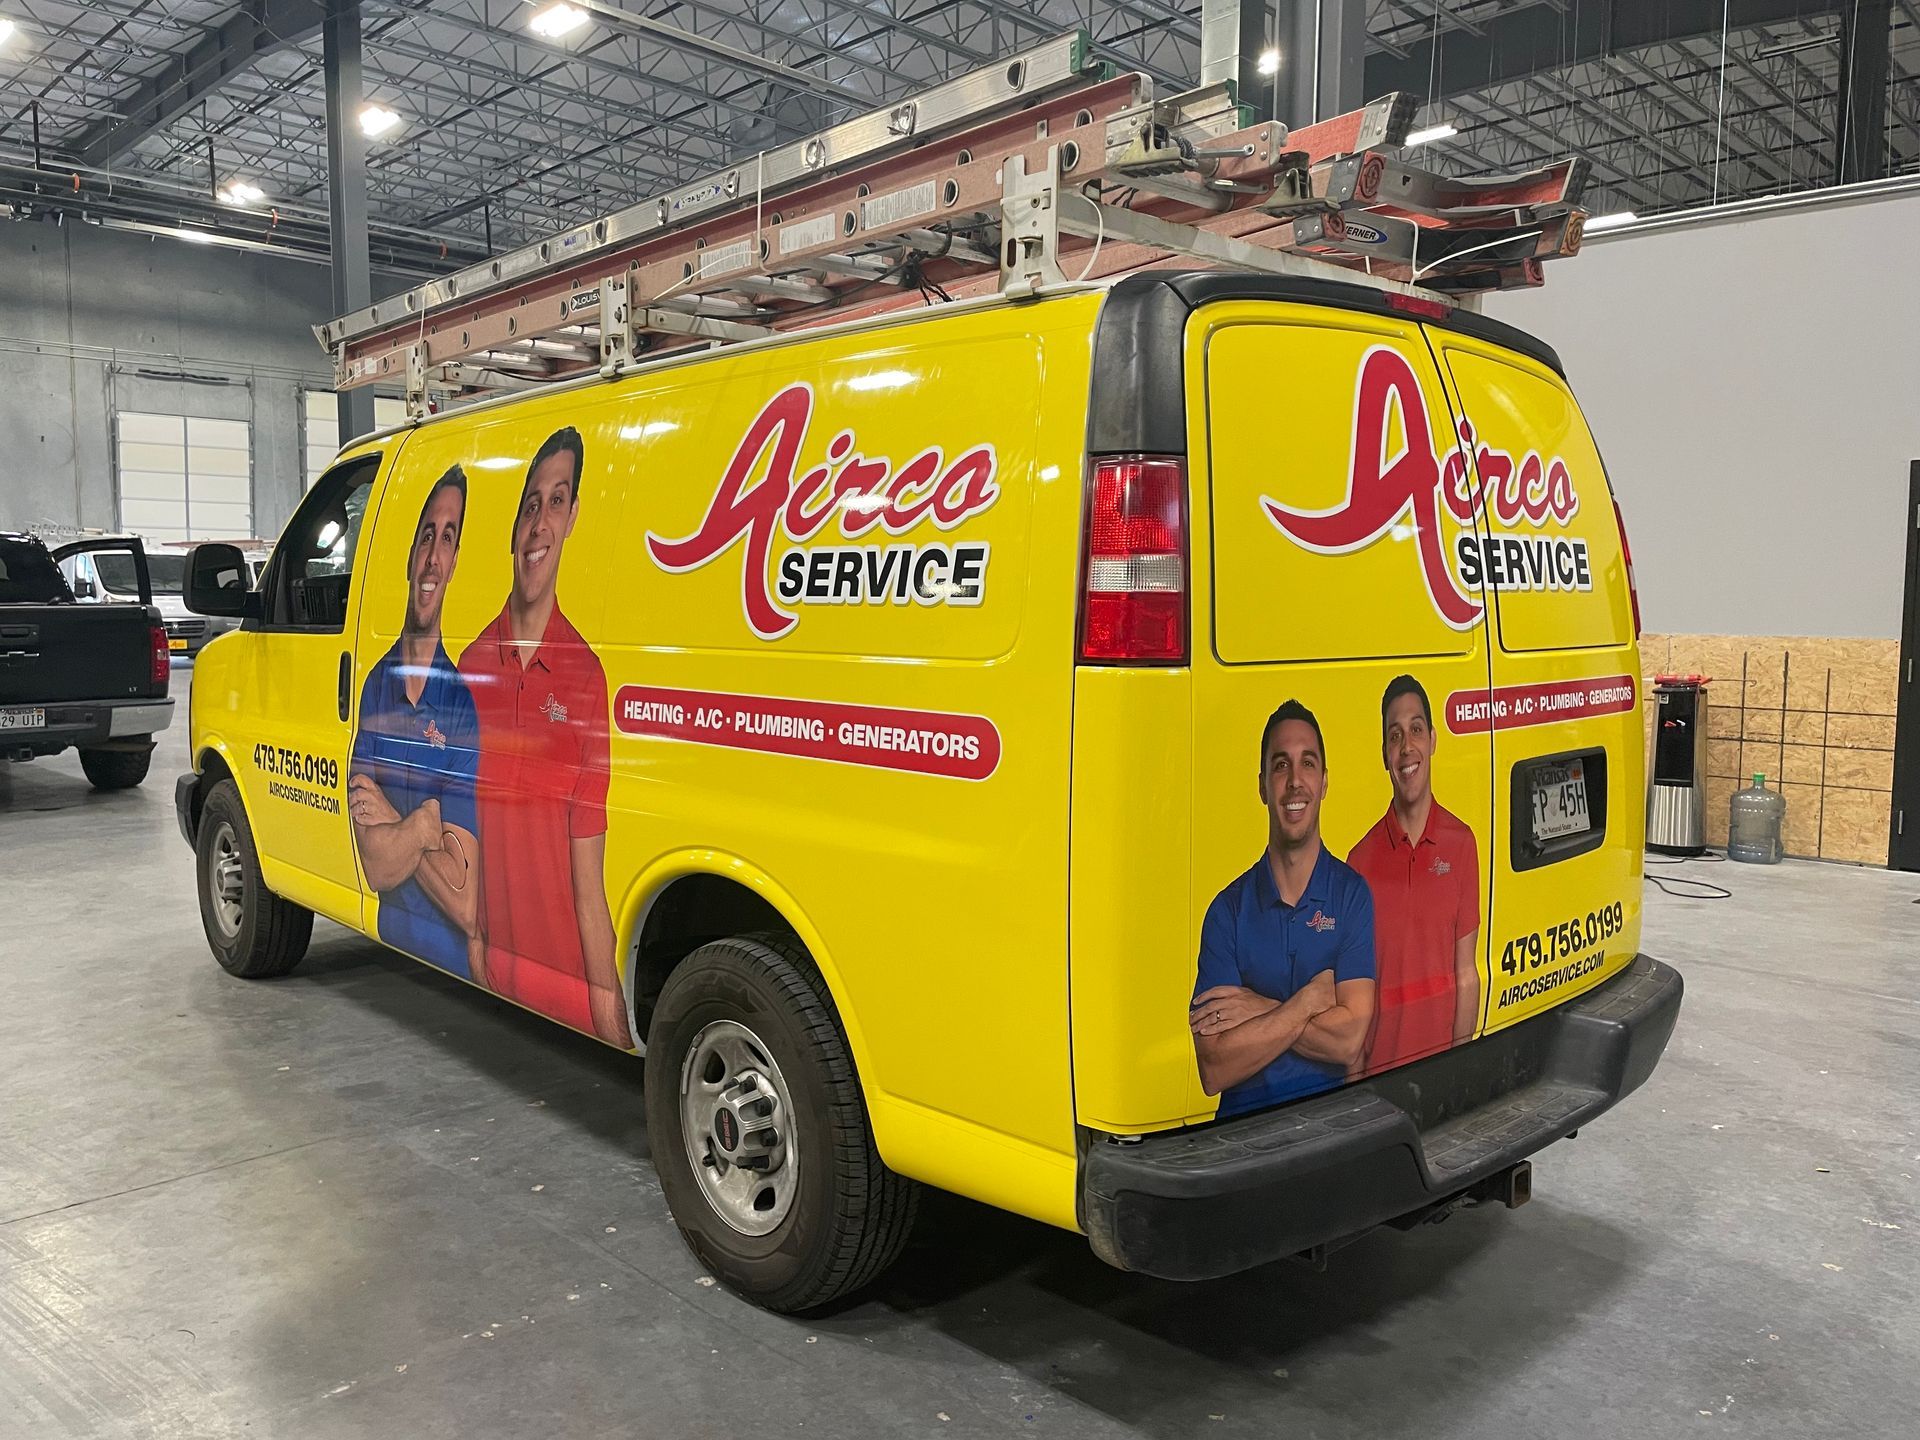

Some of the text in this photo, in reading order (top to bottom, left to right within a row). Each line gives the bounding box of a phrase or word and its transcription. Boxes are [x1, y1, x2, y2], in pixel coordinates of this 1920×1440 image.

[1345, 226, 1377, 240] ERNER
[645, 381, 1000, 641] Airco
[1259, 343, 1579, 632] Airco
[776, 545, 987, 602] SERVICE
[1456, 534, 1591, 588] SERVICE
[0, 714, 44, 728] 29 UIP
[623, 699, 980, 761] HEATING A/C PLUMBING GENERATORS
[1455, 685, 1632, 722] HEATING A/C PLUMBING GENERATORS
[253, 743, 339, 790] 479.756.0199
[269, 780, 341, 816] AIRCOSERVICE.COM
[1559, 782, 1587, 818] 45H
[1501, 901, 1623, 977] 479.756.0199
[1497, 949, 1606, 1010] AIRCOSERVICE.COM
